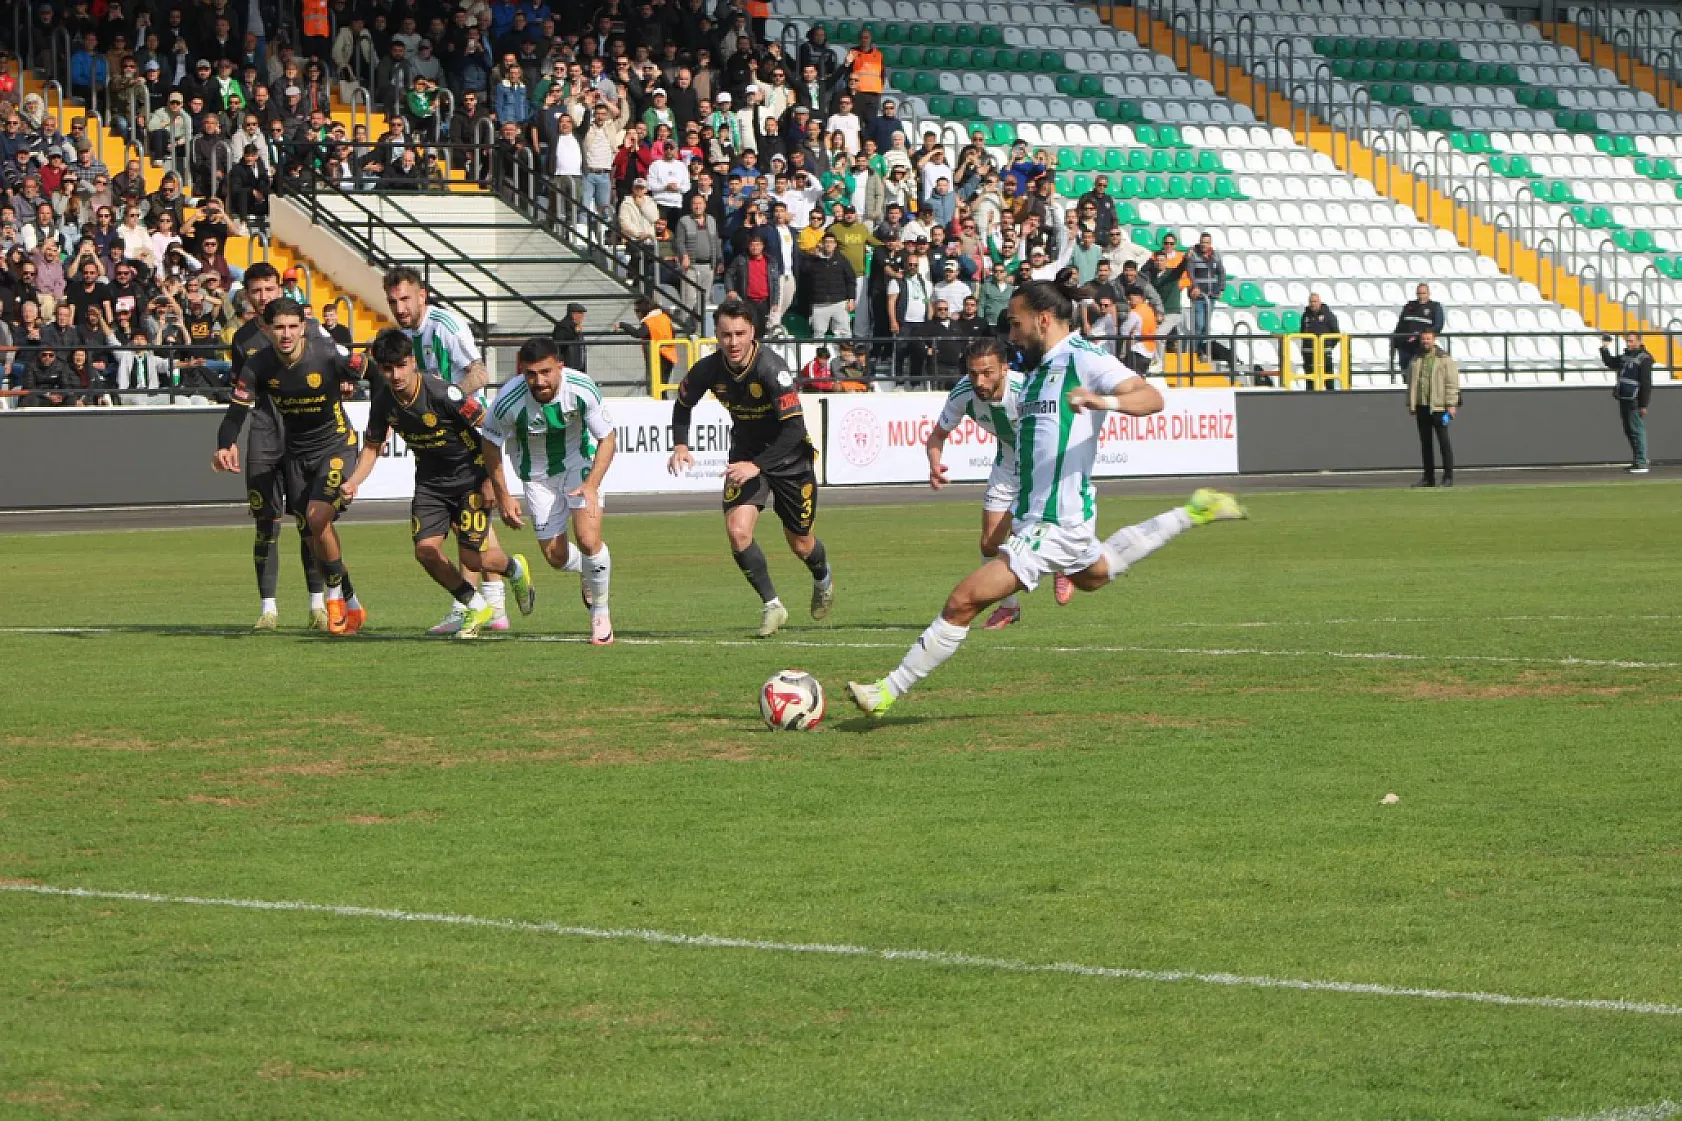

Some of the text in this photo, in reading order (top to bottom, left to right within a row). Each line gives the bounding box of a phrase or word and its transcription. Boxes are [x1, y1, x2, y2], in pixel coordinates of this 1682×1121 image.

[1098, 414, 1168, 448] ŞARILAR
[1171, 408, 1234, 439] DİLERİZ
[327, 470, 341, 487] 9
[800, 499, 812, 519] 3
[460, 510, 487, 532] 90
